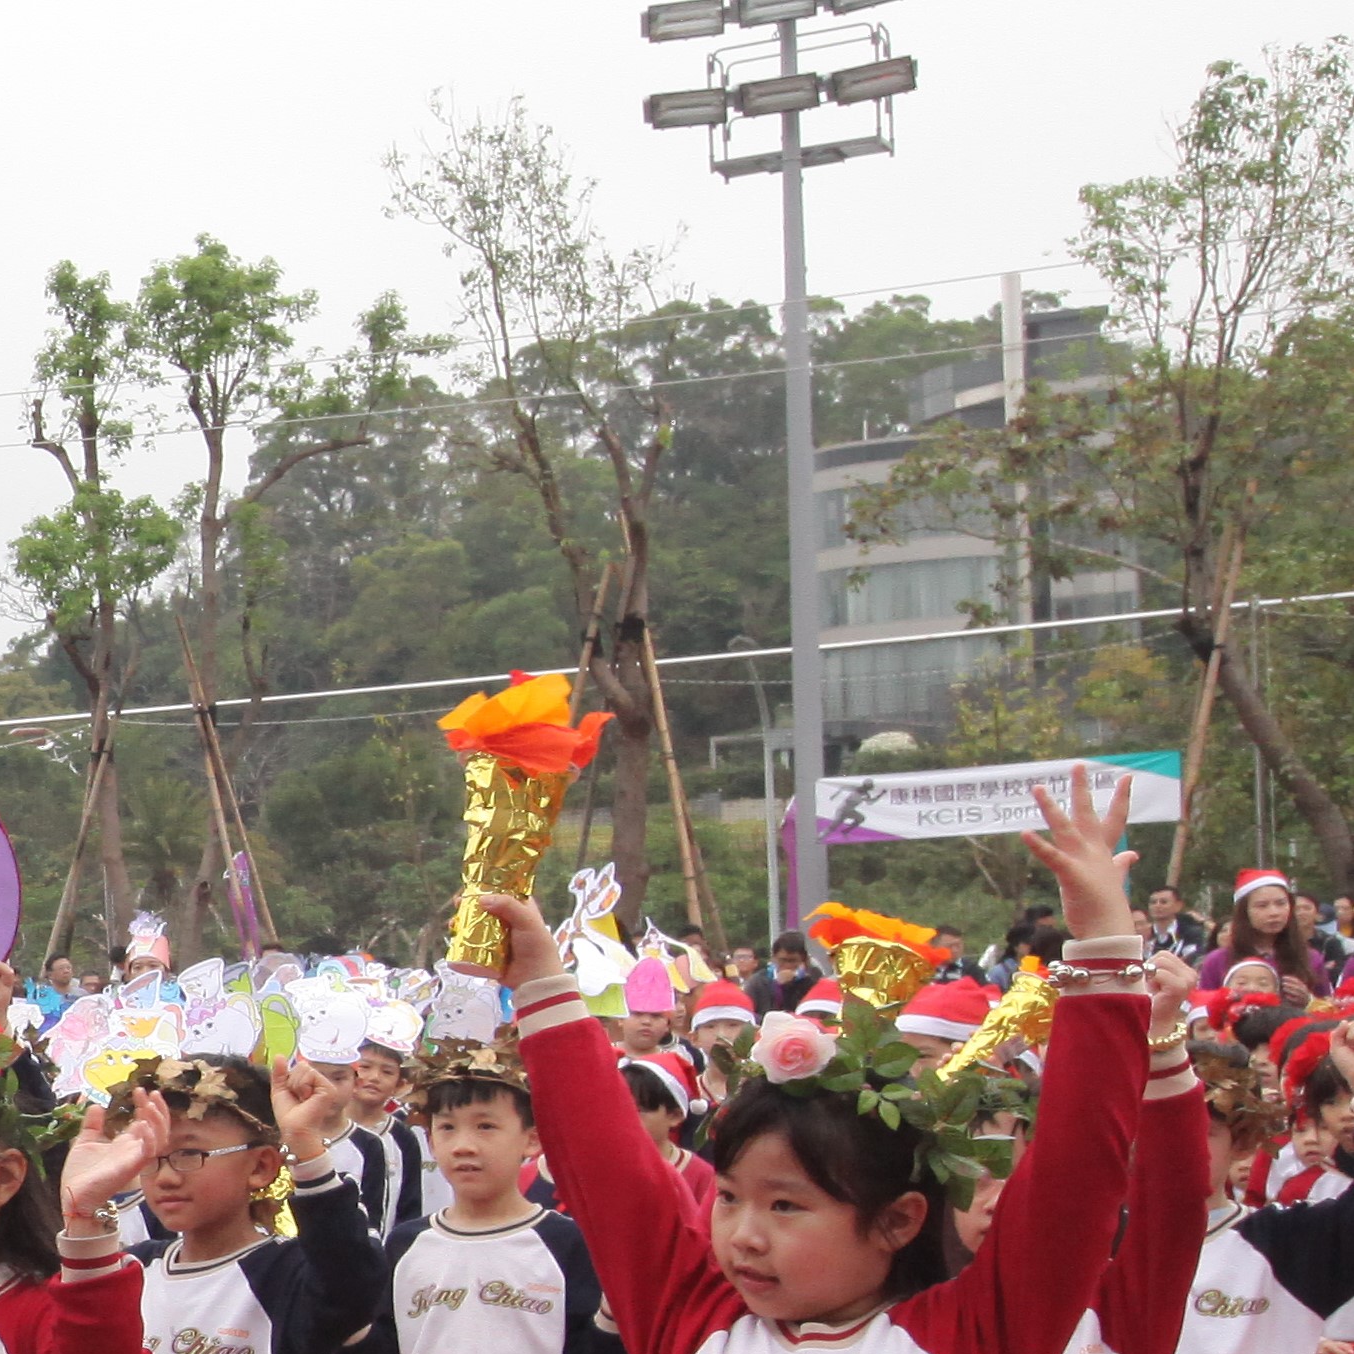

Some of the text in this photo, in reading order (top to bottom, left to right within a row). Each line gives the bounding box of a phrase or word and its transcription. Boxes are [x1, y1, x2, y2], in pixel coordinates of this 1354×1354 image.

[918, 806, 984, 827] KCIS
[478, 1279, 554, 1315] Chiao
[1193, 1289, 1270, 1318] Chiao
